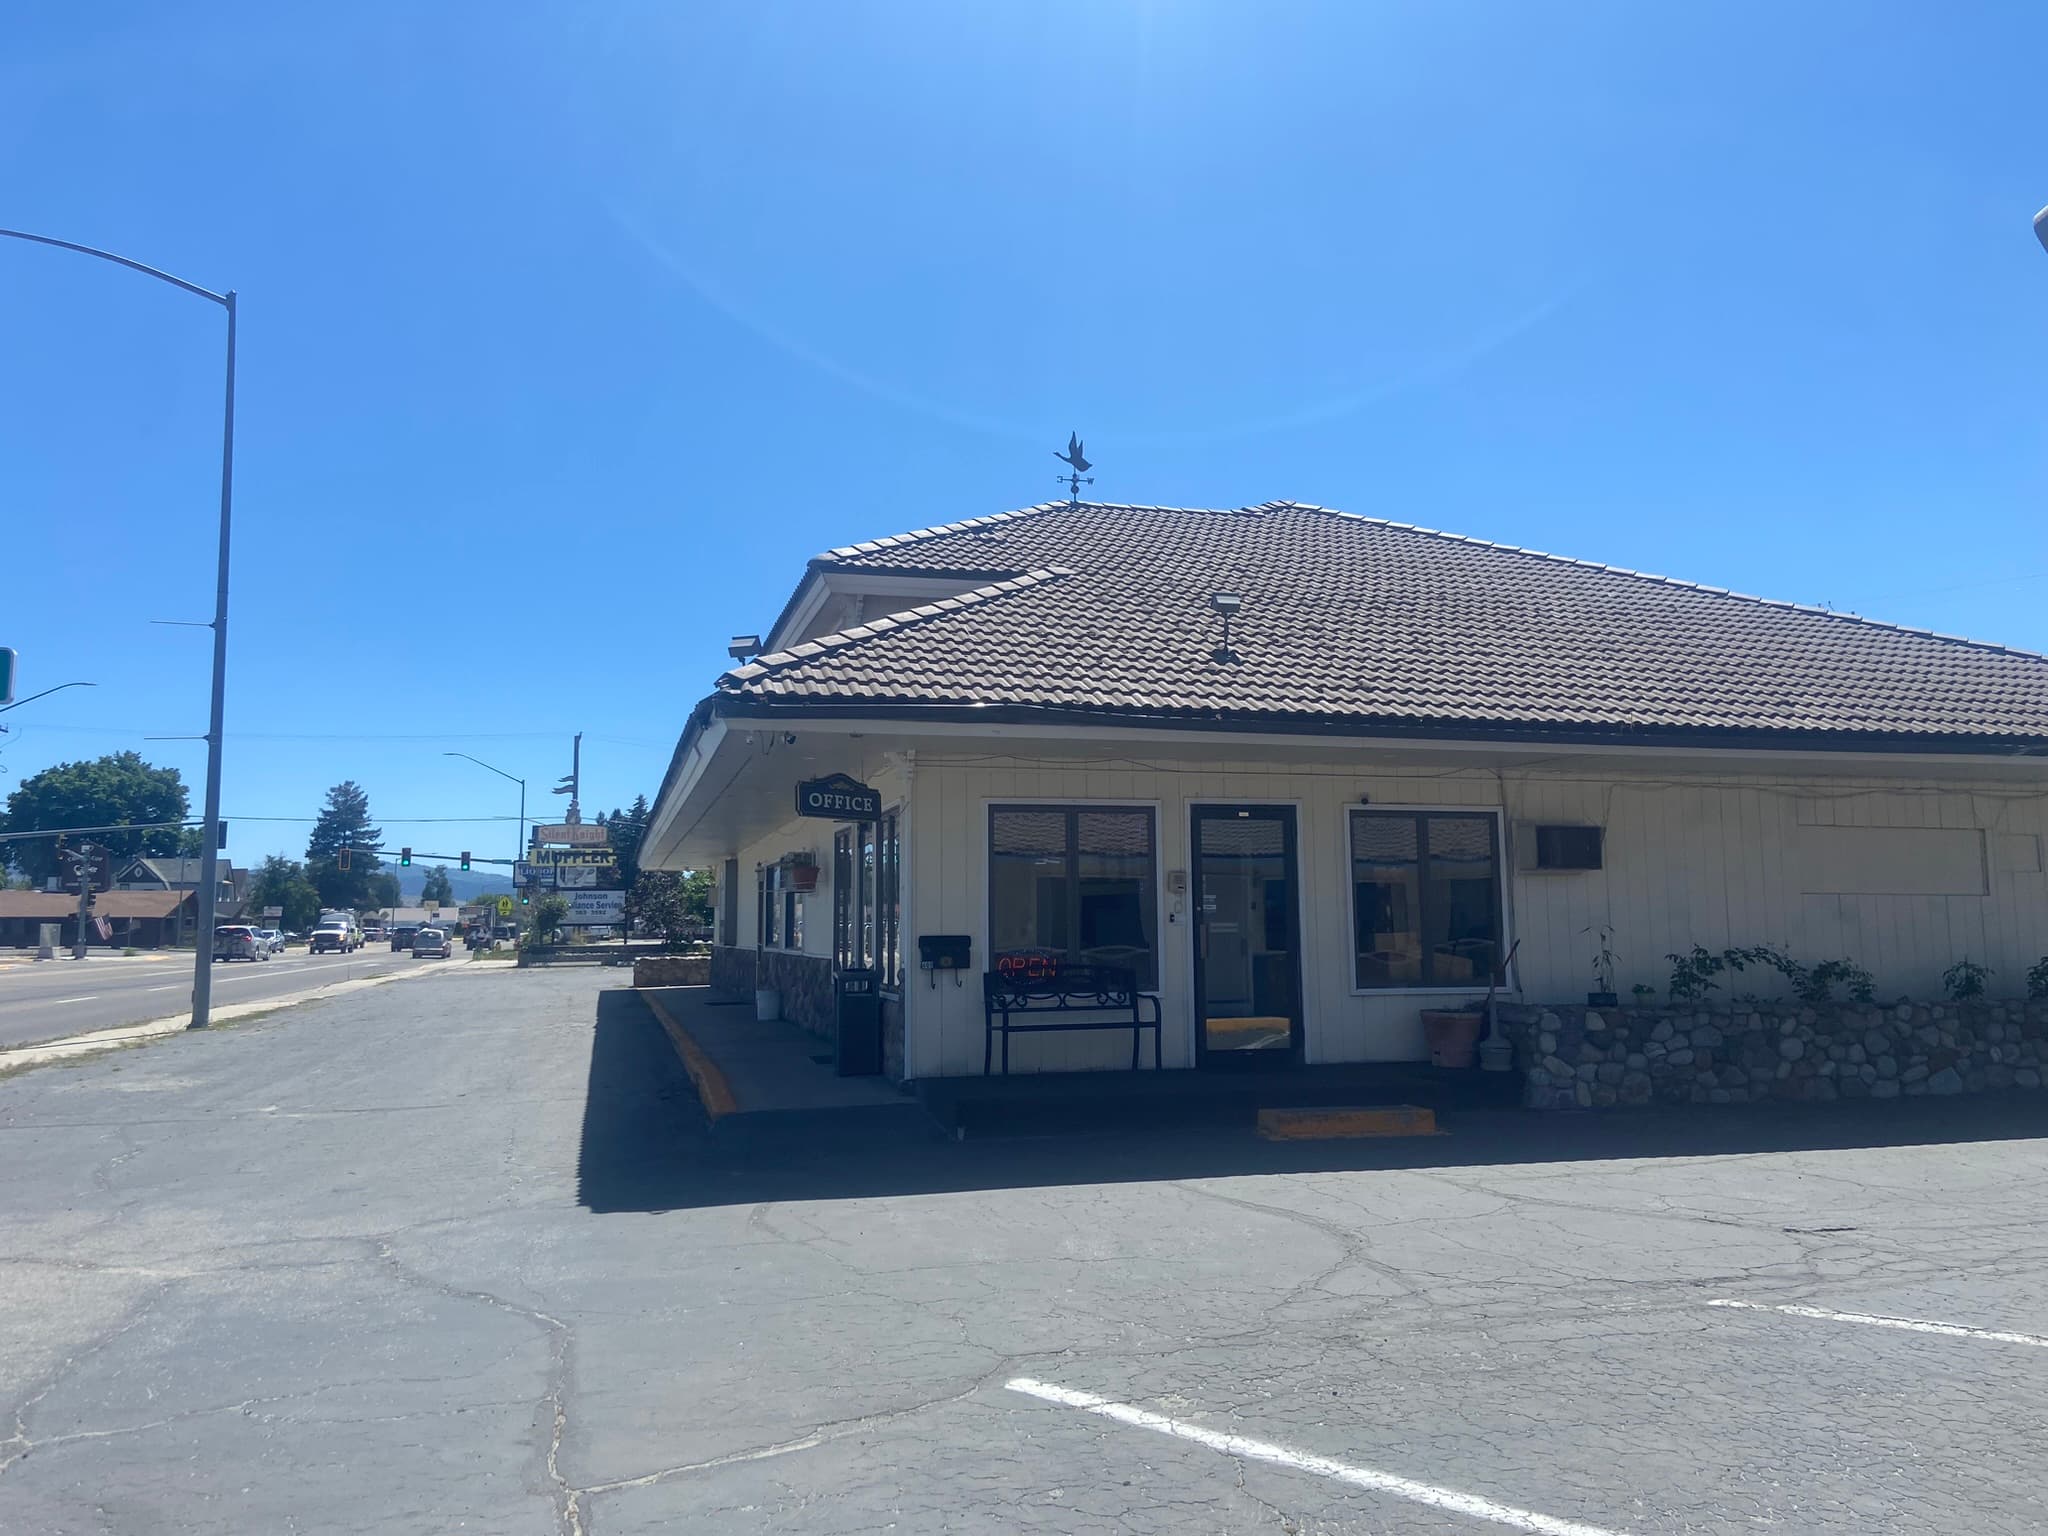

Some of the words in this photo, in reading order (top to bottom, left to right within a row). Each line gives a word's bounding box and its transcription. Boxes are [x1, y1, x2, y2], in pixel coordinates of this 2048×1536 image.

[809, 792, 873, 812] OFFICE
[574, 892, 608, 900] Johnson
[998, 957, 1057, 977] OPEN
